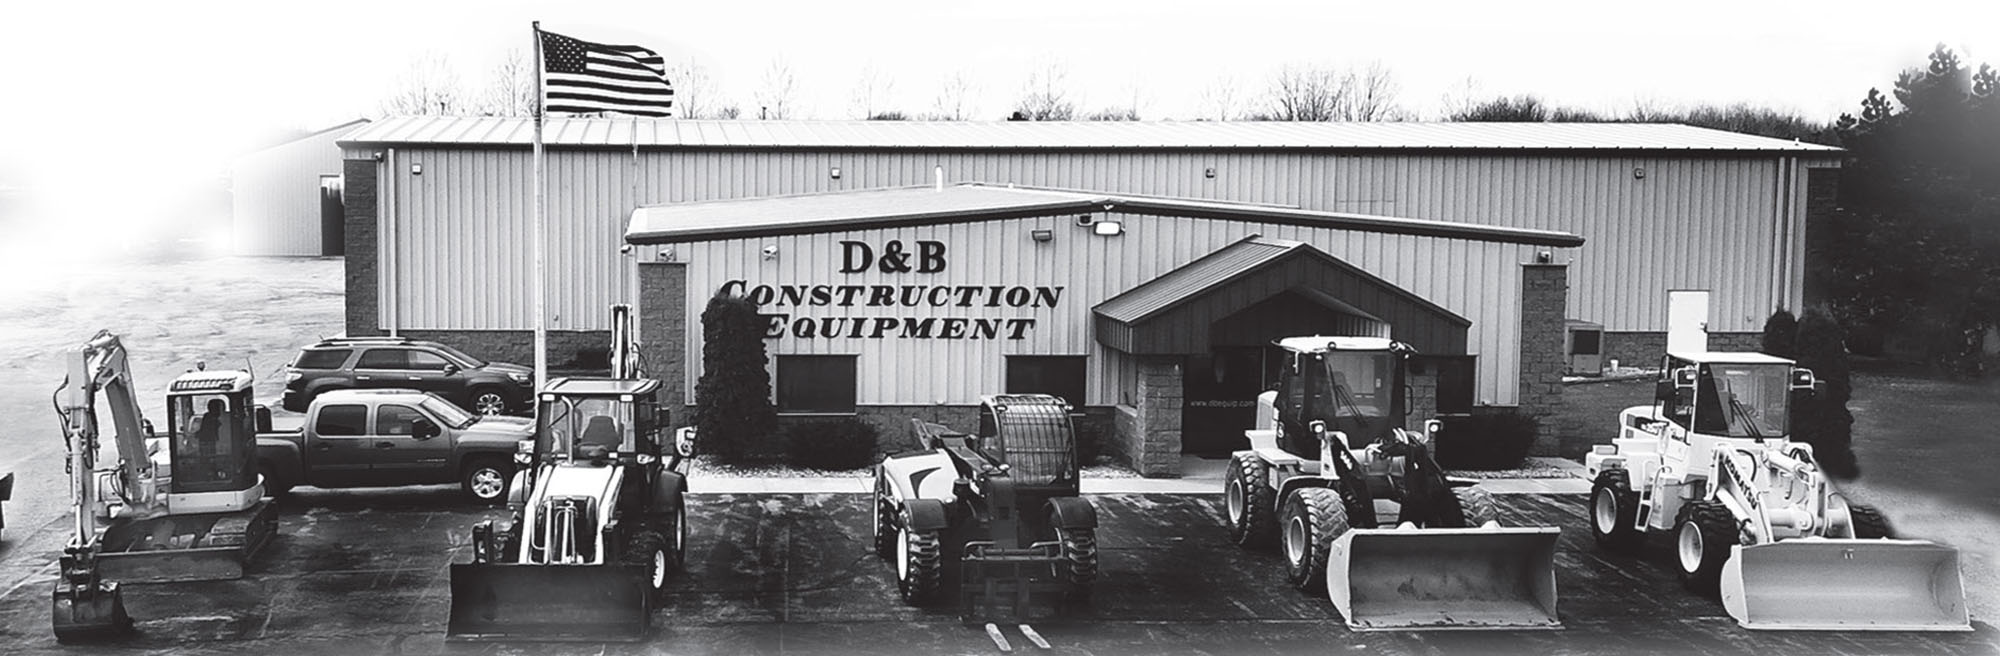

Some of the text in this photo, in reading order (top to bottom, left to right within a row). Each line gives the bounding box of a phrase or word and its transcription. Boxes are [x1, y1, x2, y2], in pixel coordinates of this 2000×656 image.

[839, 239, 948, 274] D&B
[757, 313, 1036, 340] EQUIPMENT
[1724, 455, 1758, 510] KOMATSU
